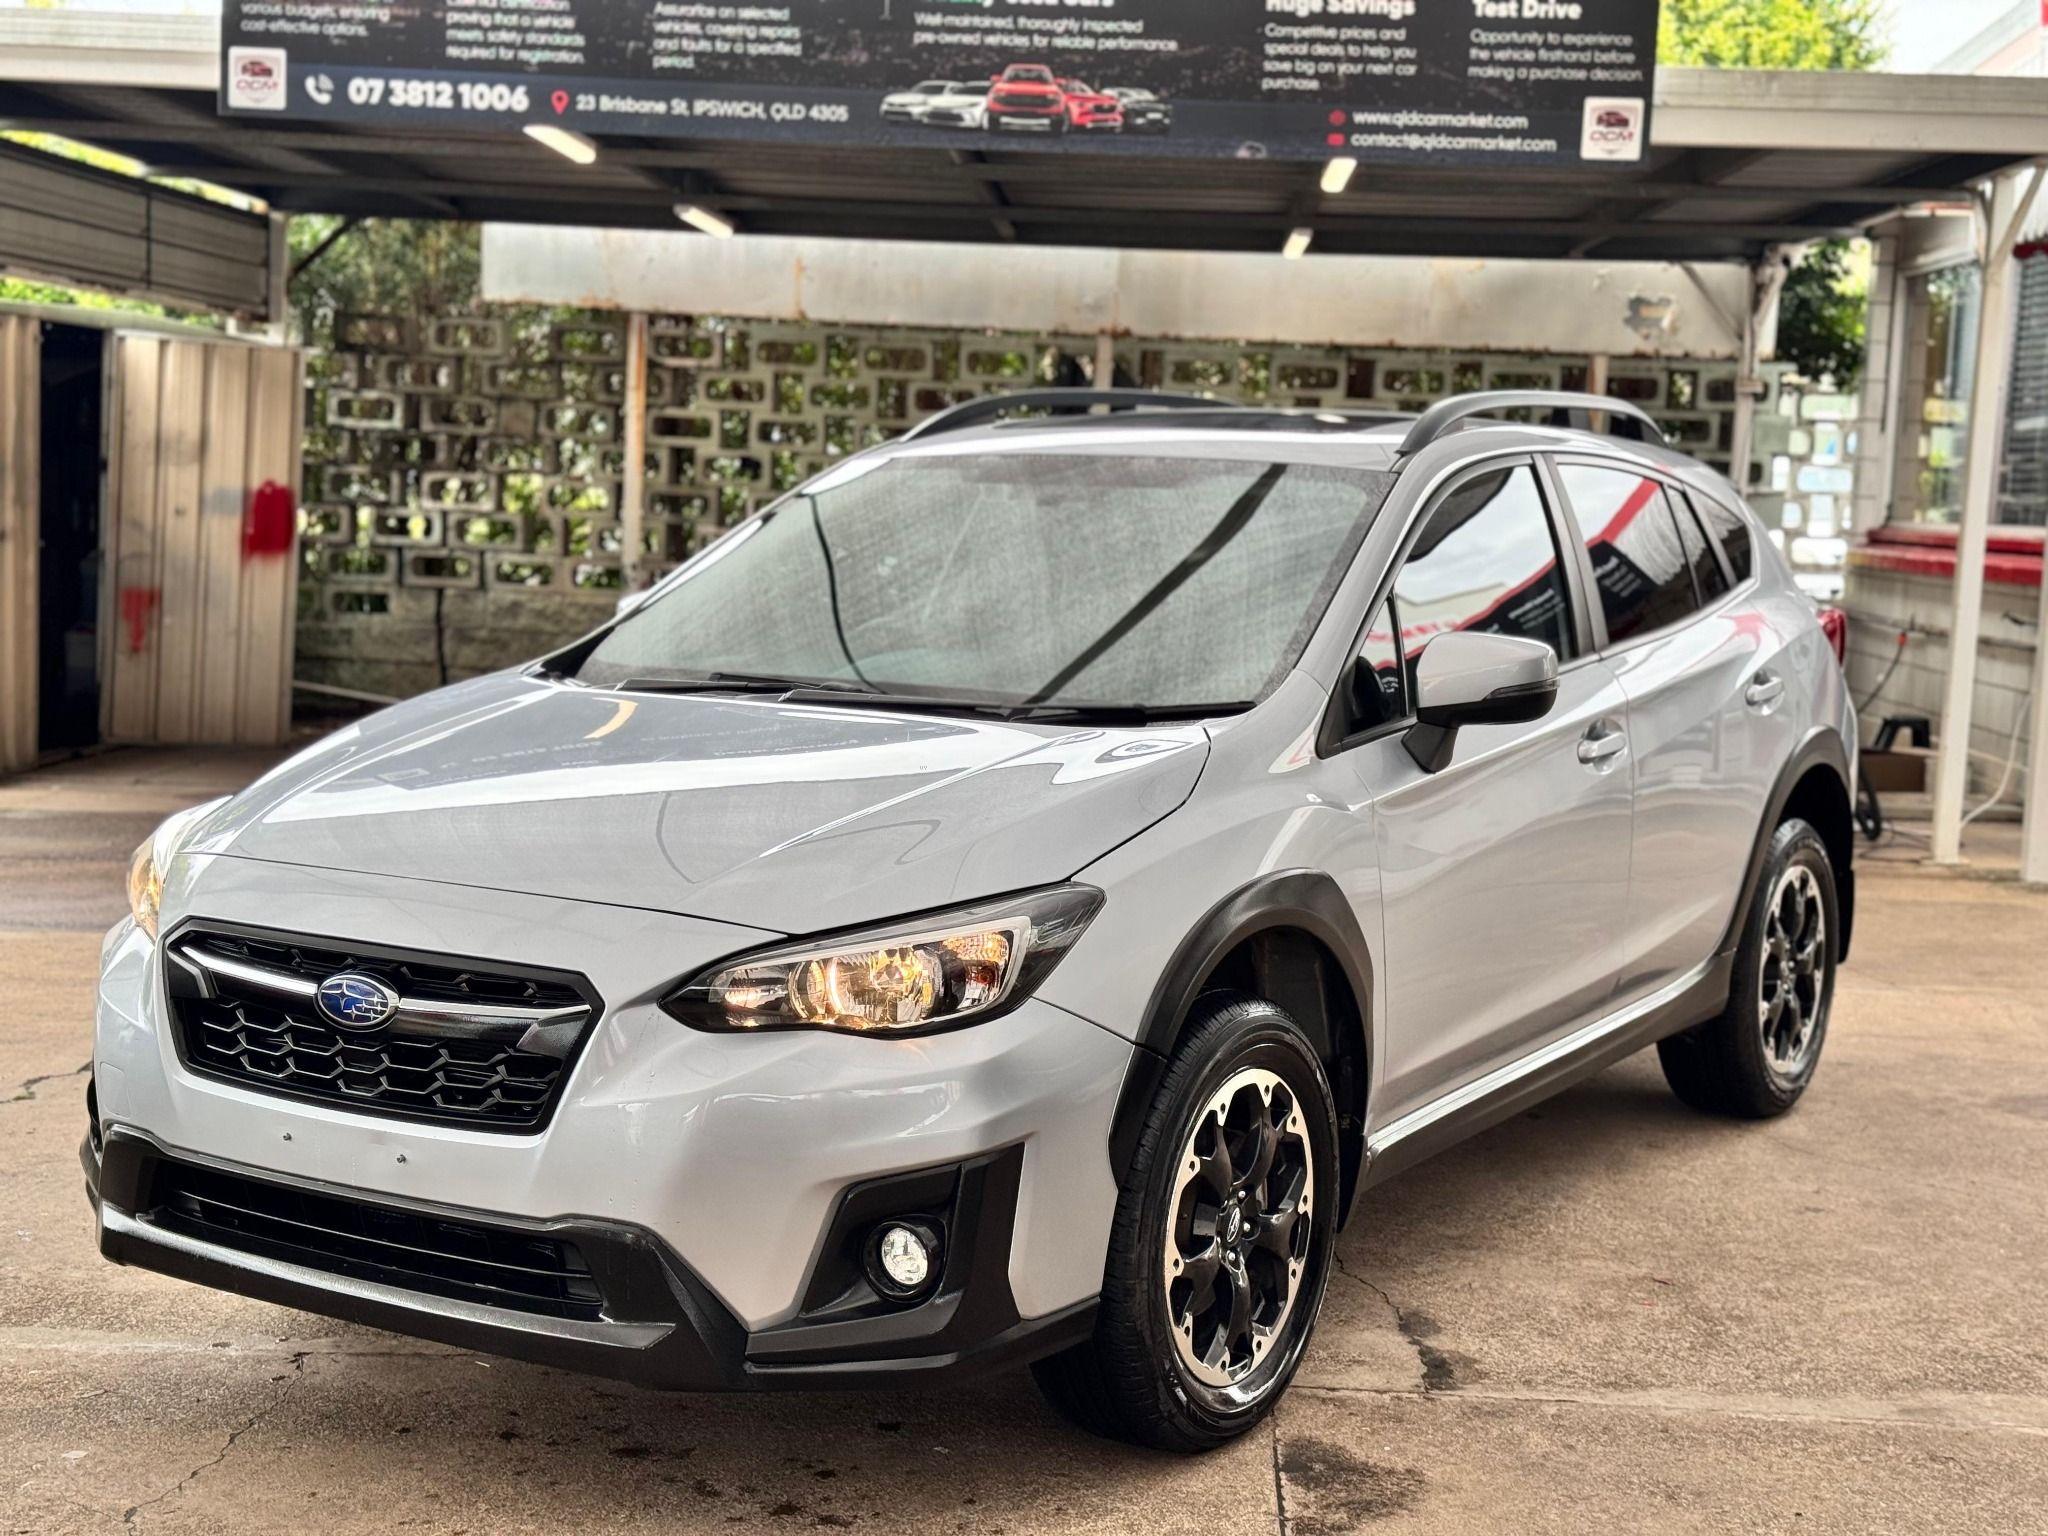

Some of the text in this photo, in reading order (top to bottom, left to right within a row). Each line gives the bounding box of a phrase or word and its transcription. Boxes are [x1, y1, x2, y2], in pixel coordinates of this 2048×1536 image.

[738, 7, 790, 21] selected
[1265, 0, 1416, 20] Huge Savings
[1472, 0, 1583, 20] Test Drive
[704, 24, 758, 39] covering
[760, 25, 801, 39] repairs
[1082, 17, 1144, 34] inspected
[1264, 22, 1406, 41] Competitive prices and
[486, 30, 524, 46] safety
[525, 32, 586, 47] standards
[913, 31, 981, 48] pre-owned
[983, 33, 1031, 48] vehicles
[1032, 33, 1049, 48] for
[1051, 35, 1096, 49] reliable
[1470, 28, 1633, 47] Opportunity to experience
[446, 46, 497, 60] required
[498, 48, 515, 60] for
[653, 39, 679, 51] and
[715, 39, 731, 53] for
[733, 43, 744, 53] a
[746, 42, 802, 56] specified
[1264, 43, 1417, 60] special deals to help you
[1470, 48, 1636, 64] the vehicle firsthand before
[1263, 60, 1418, 77] save big on your next car
[1468, 66, 1516, 81] making
[1517, 69, 1528, 79] a
[1529, 68, 1588, 81] purchase
[348, 77, 530, 112] 07 3812 1006
[575, 94, 850, 122] 23 Brisbane St, IPSWICH, QLD 4305
[1352, 110, 1529, 130] www.qldcarmarket.com
[1350, 132, 1558, 153] contact@qldcarmarket.com
